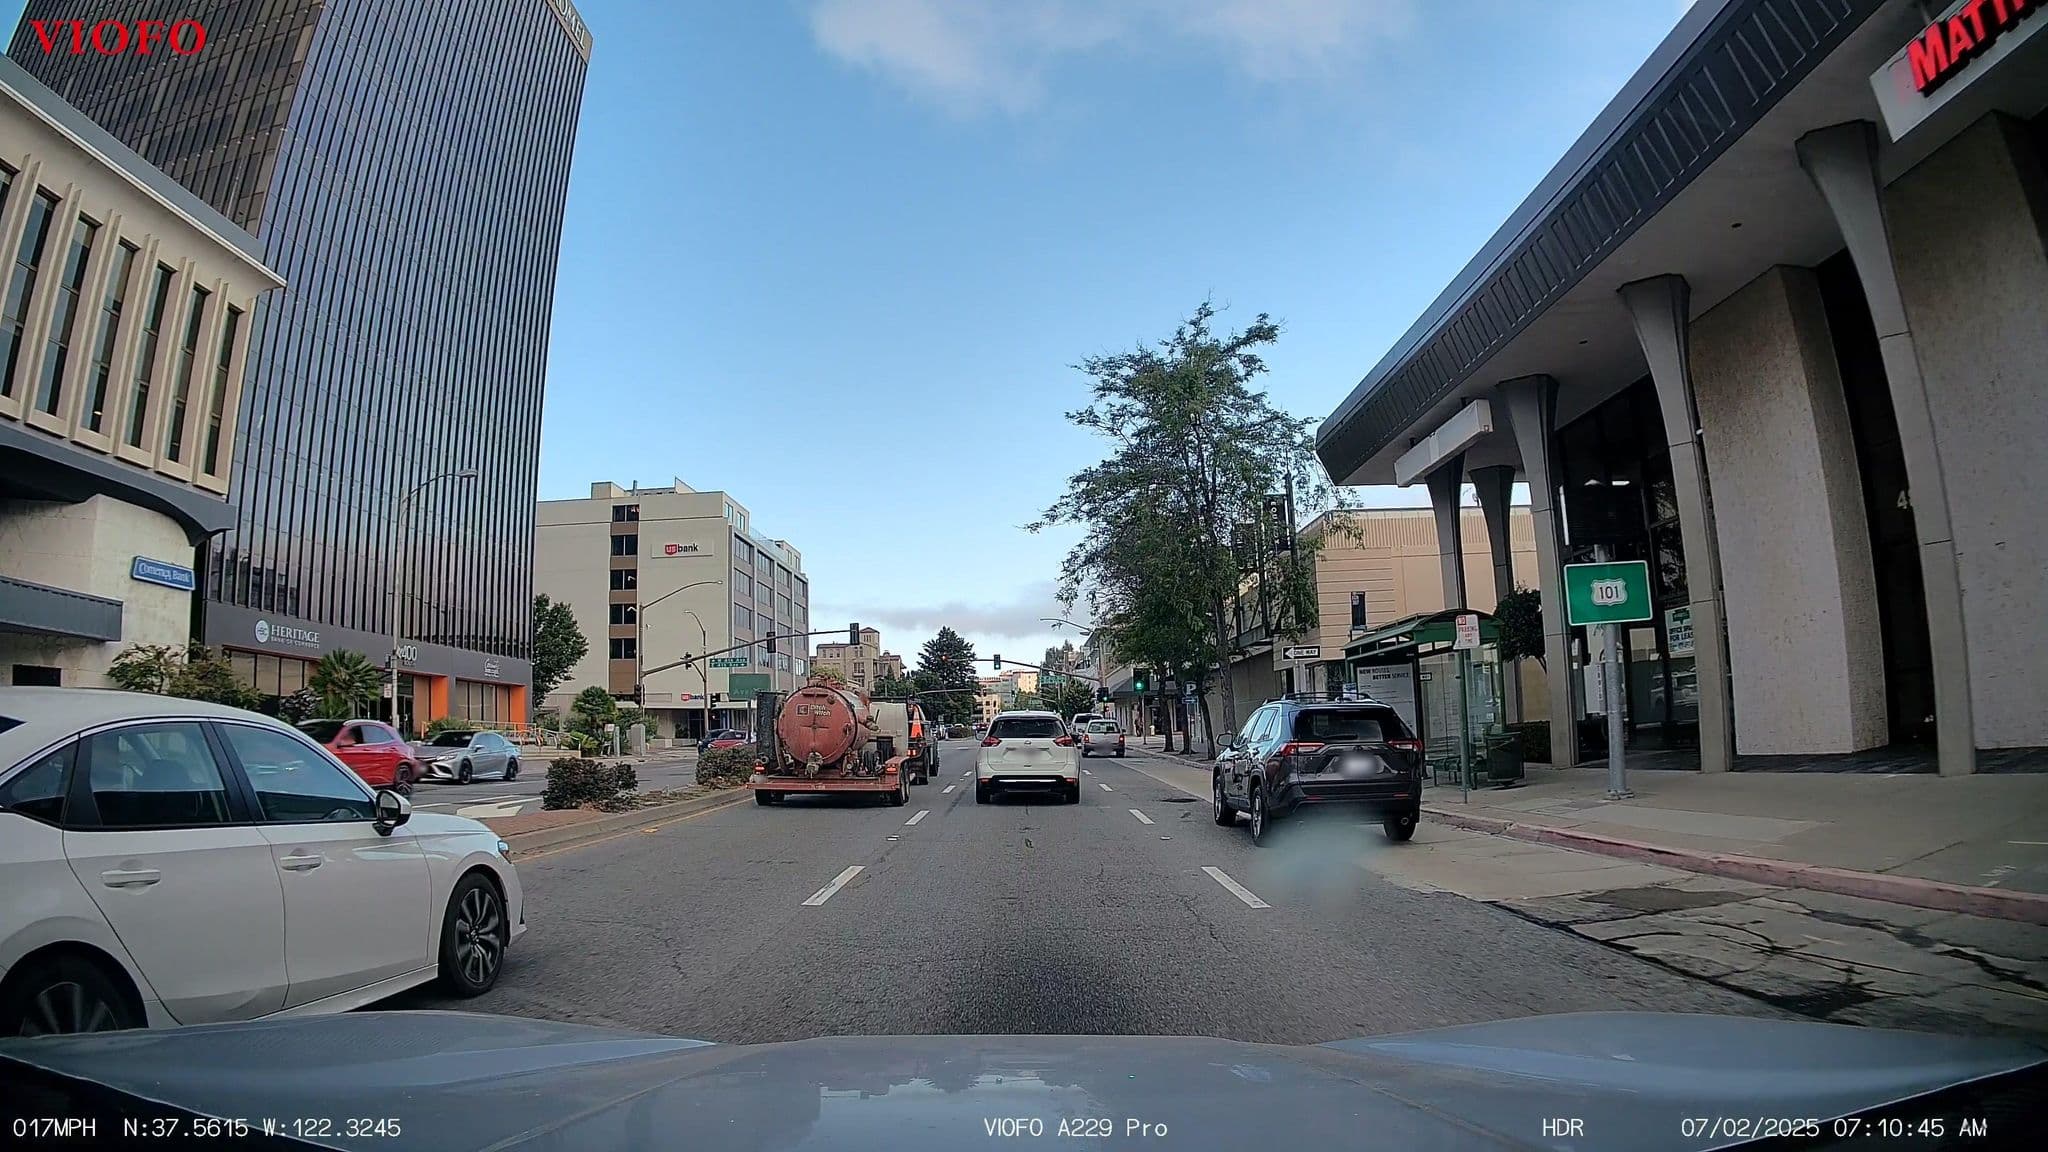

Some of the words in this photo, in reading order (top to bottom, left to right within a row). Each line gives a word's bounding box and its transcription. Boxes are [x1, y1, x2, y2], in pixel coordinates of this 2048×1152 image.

[172, 570, 190, 583] Bank
[1599, 585, 1619, 600] 101
[271, 624, 320, 643] HERITAGE
[1669, 634, 1680, 642] FOR
[1681, 631, 1694, 641] LEAS
[1294, 649, 1304, 657] ONE
[1304, 648, 1318, 656] WAY
[1186, 683, 1197, 695] P
